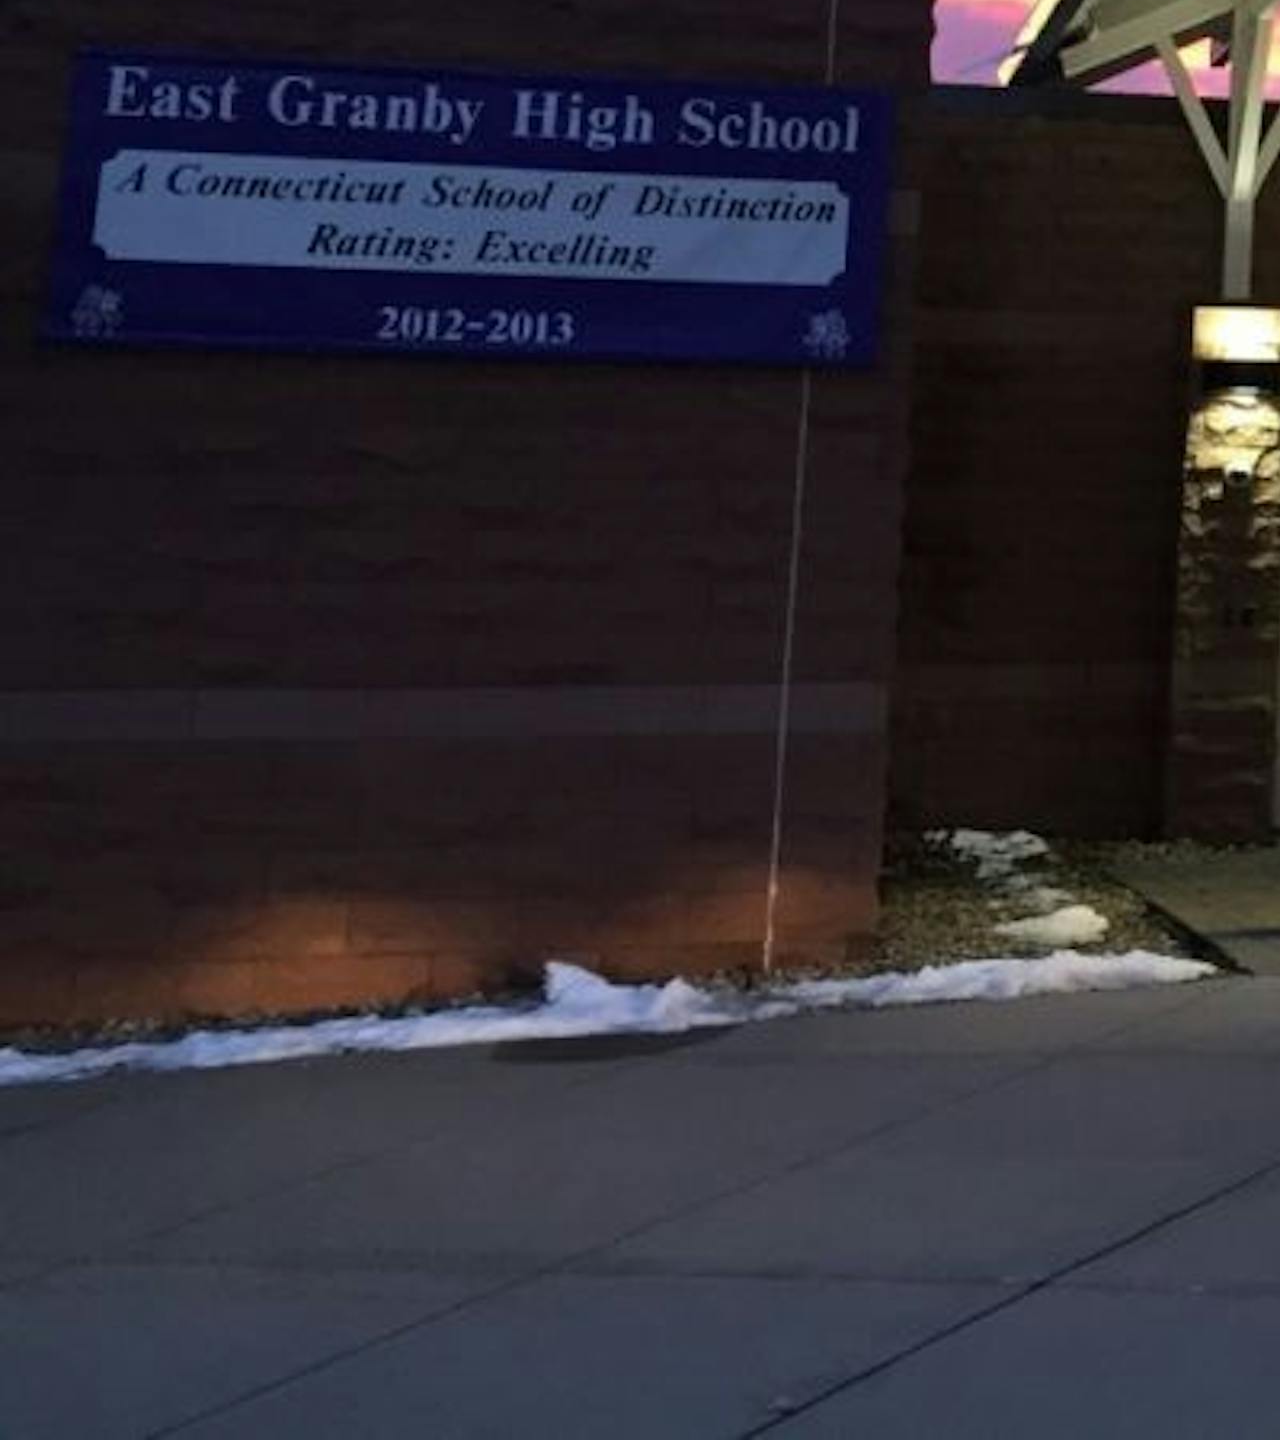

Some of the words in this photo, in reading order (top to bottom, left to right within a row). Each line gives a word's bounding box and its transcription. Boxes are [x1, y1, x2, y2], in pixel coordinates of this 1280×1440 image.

[103, 64, 243, 124] East
[267, 73, 484, 146] Granby
[511, 88, 656, 152] High
[675, 97, 861, 154] School
[113, 162, 148, 194] A
[166, 163, 407, 204] Connecticut
[422, 174, 555, 211] School
[570, 184, 615, 220] of
[632, 185, 838, 223] Distinction
[307, 223, 454, 263] Rating:
[476, 229, 655, 272] Excelling
[375, 304, 577, 345] 2012-2013
